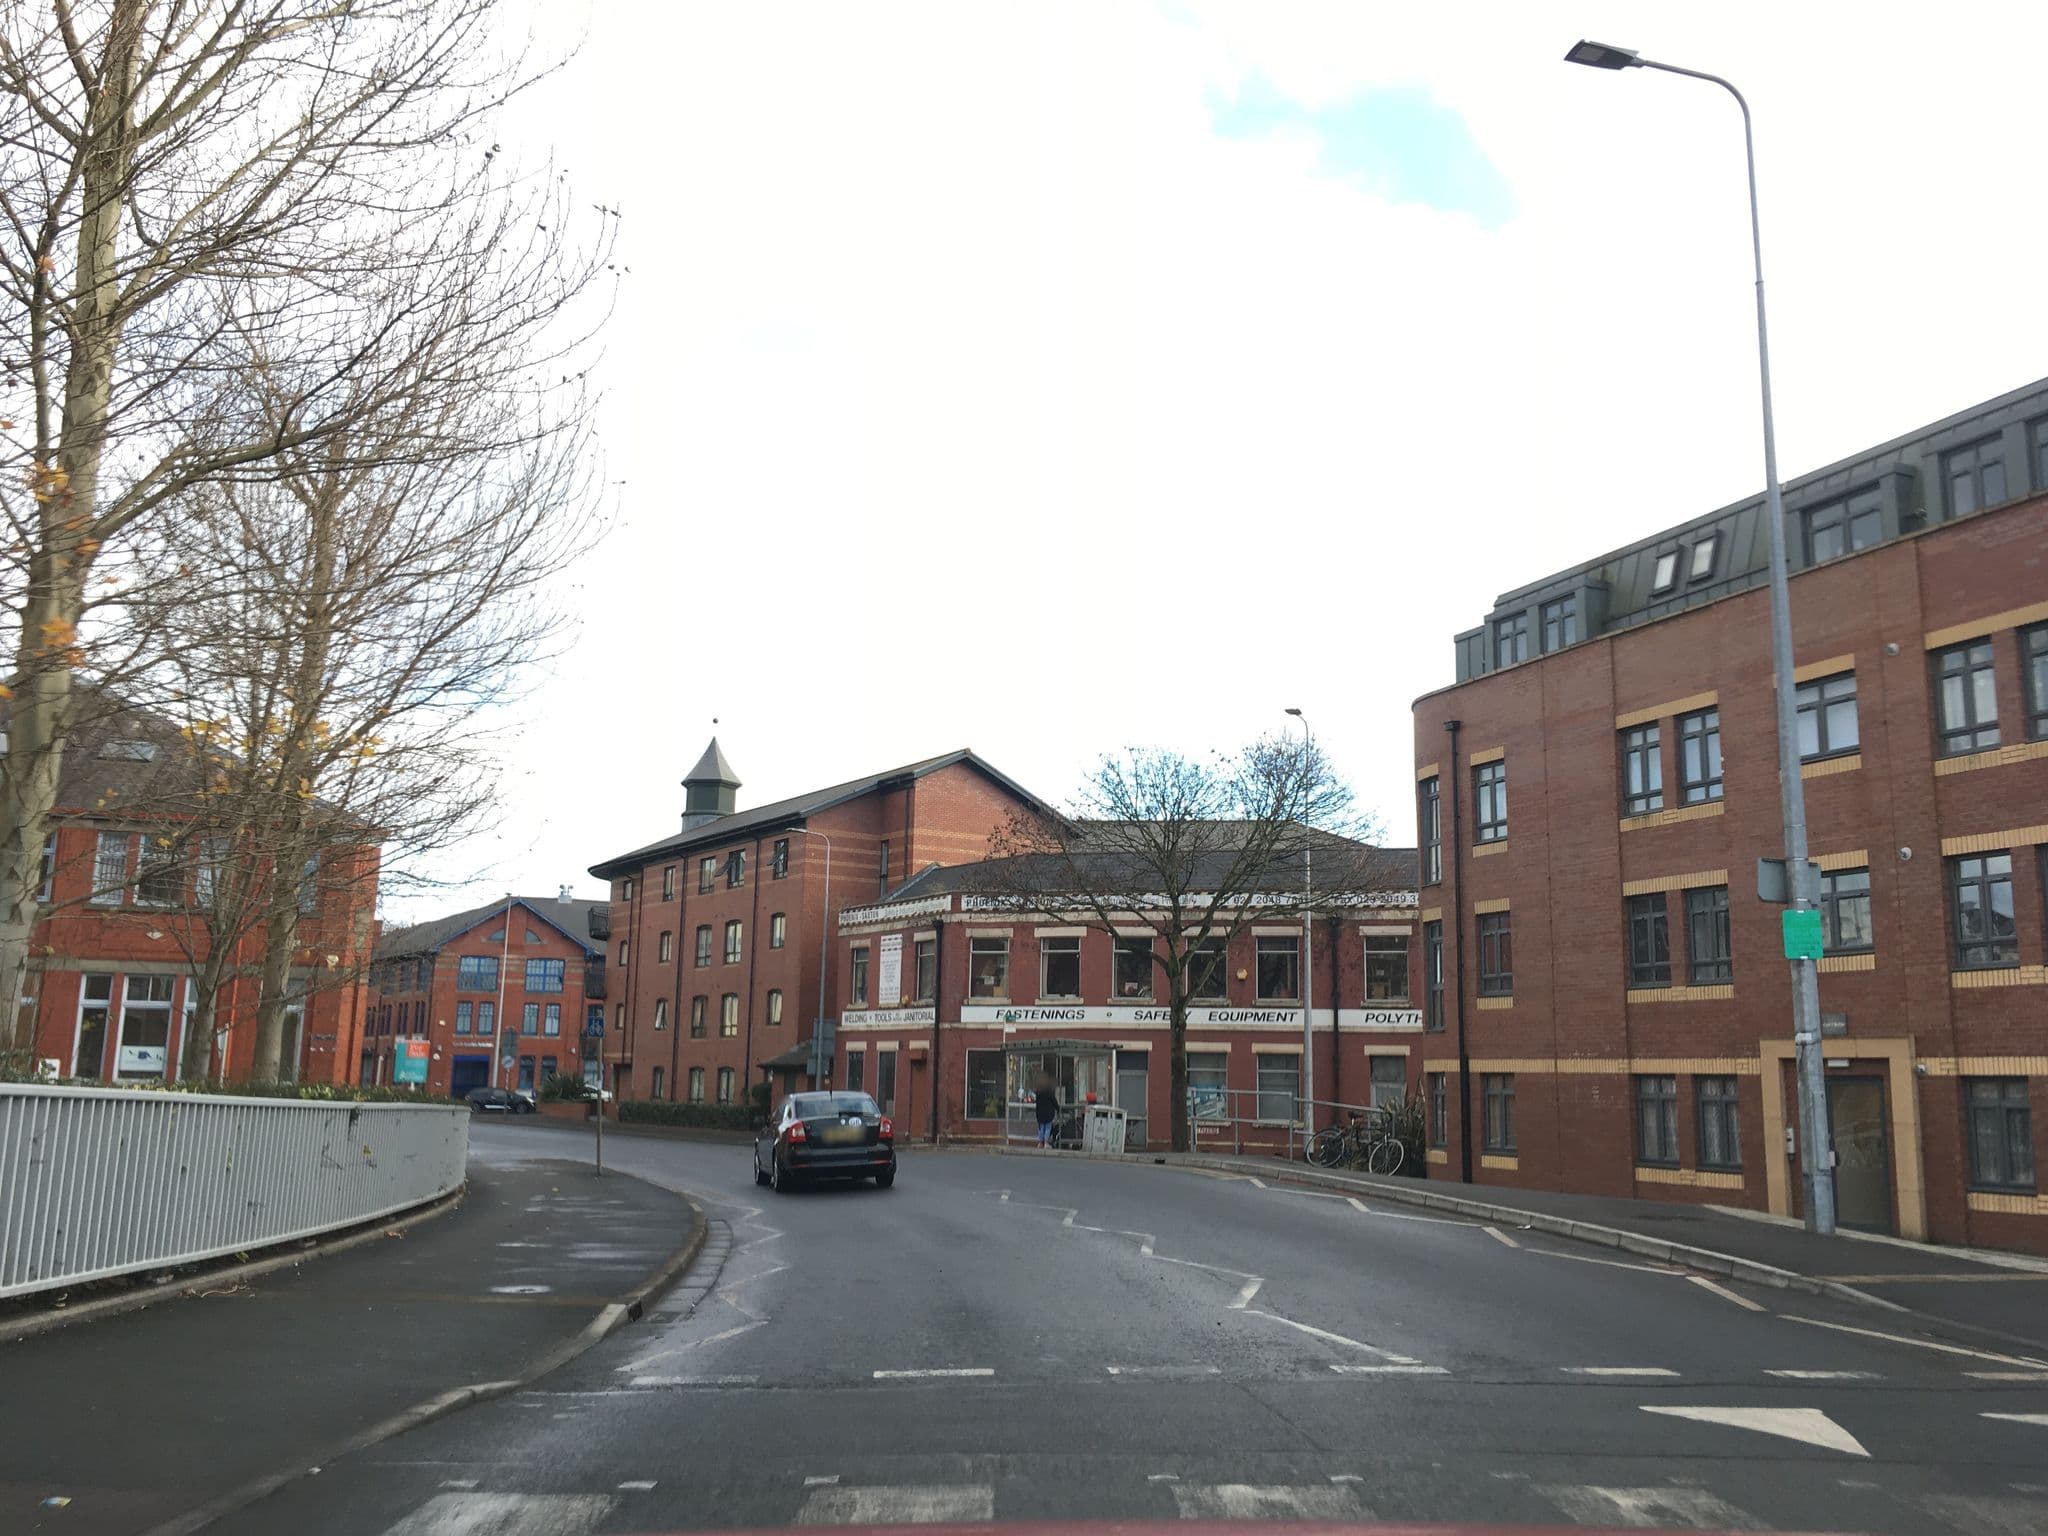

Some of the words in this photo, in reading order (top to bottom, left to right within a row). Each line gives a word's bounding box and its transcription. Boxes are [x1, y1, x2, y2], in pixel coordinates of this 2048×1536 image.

[844, 1013, 867, 1023] WELDING
[874, 1012, 892, 1022] TOOLS
[996, 1009, 1086, 1020] FASTENINGS
[1134, 1010, 1192, 1021] SAFEY
[1208, 1011, 1298, 1023] EQUIPMENT
